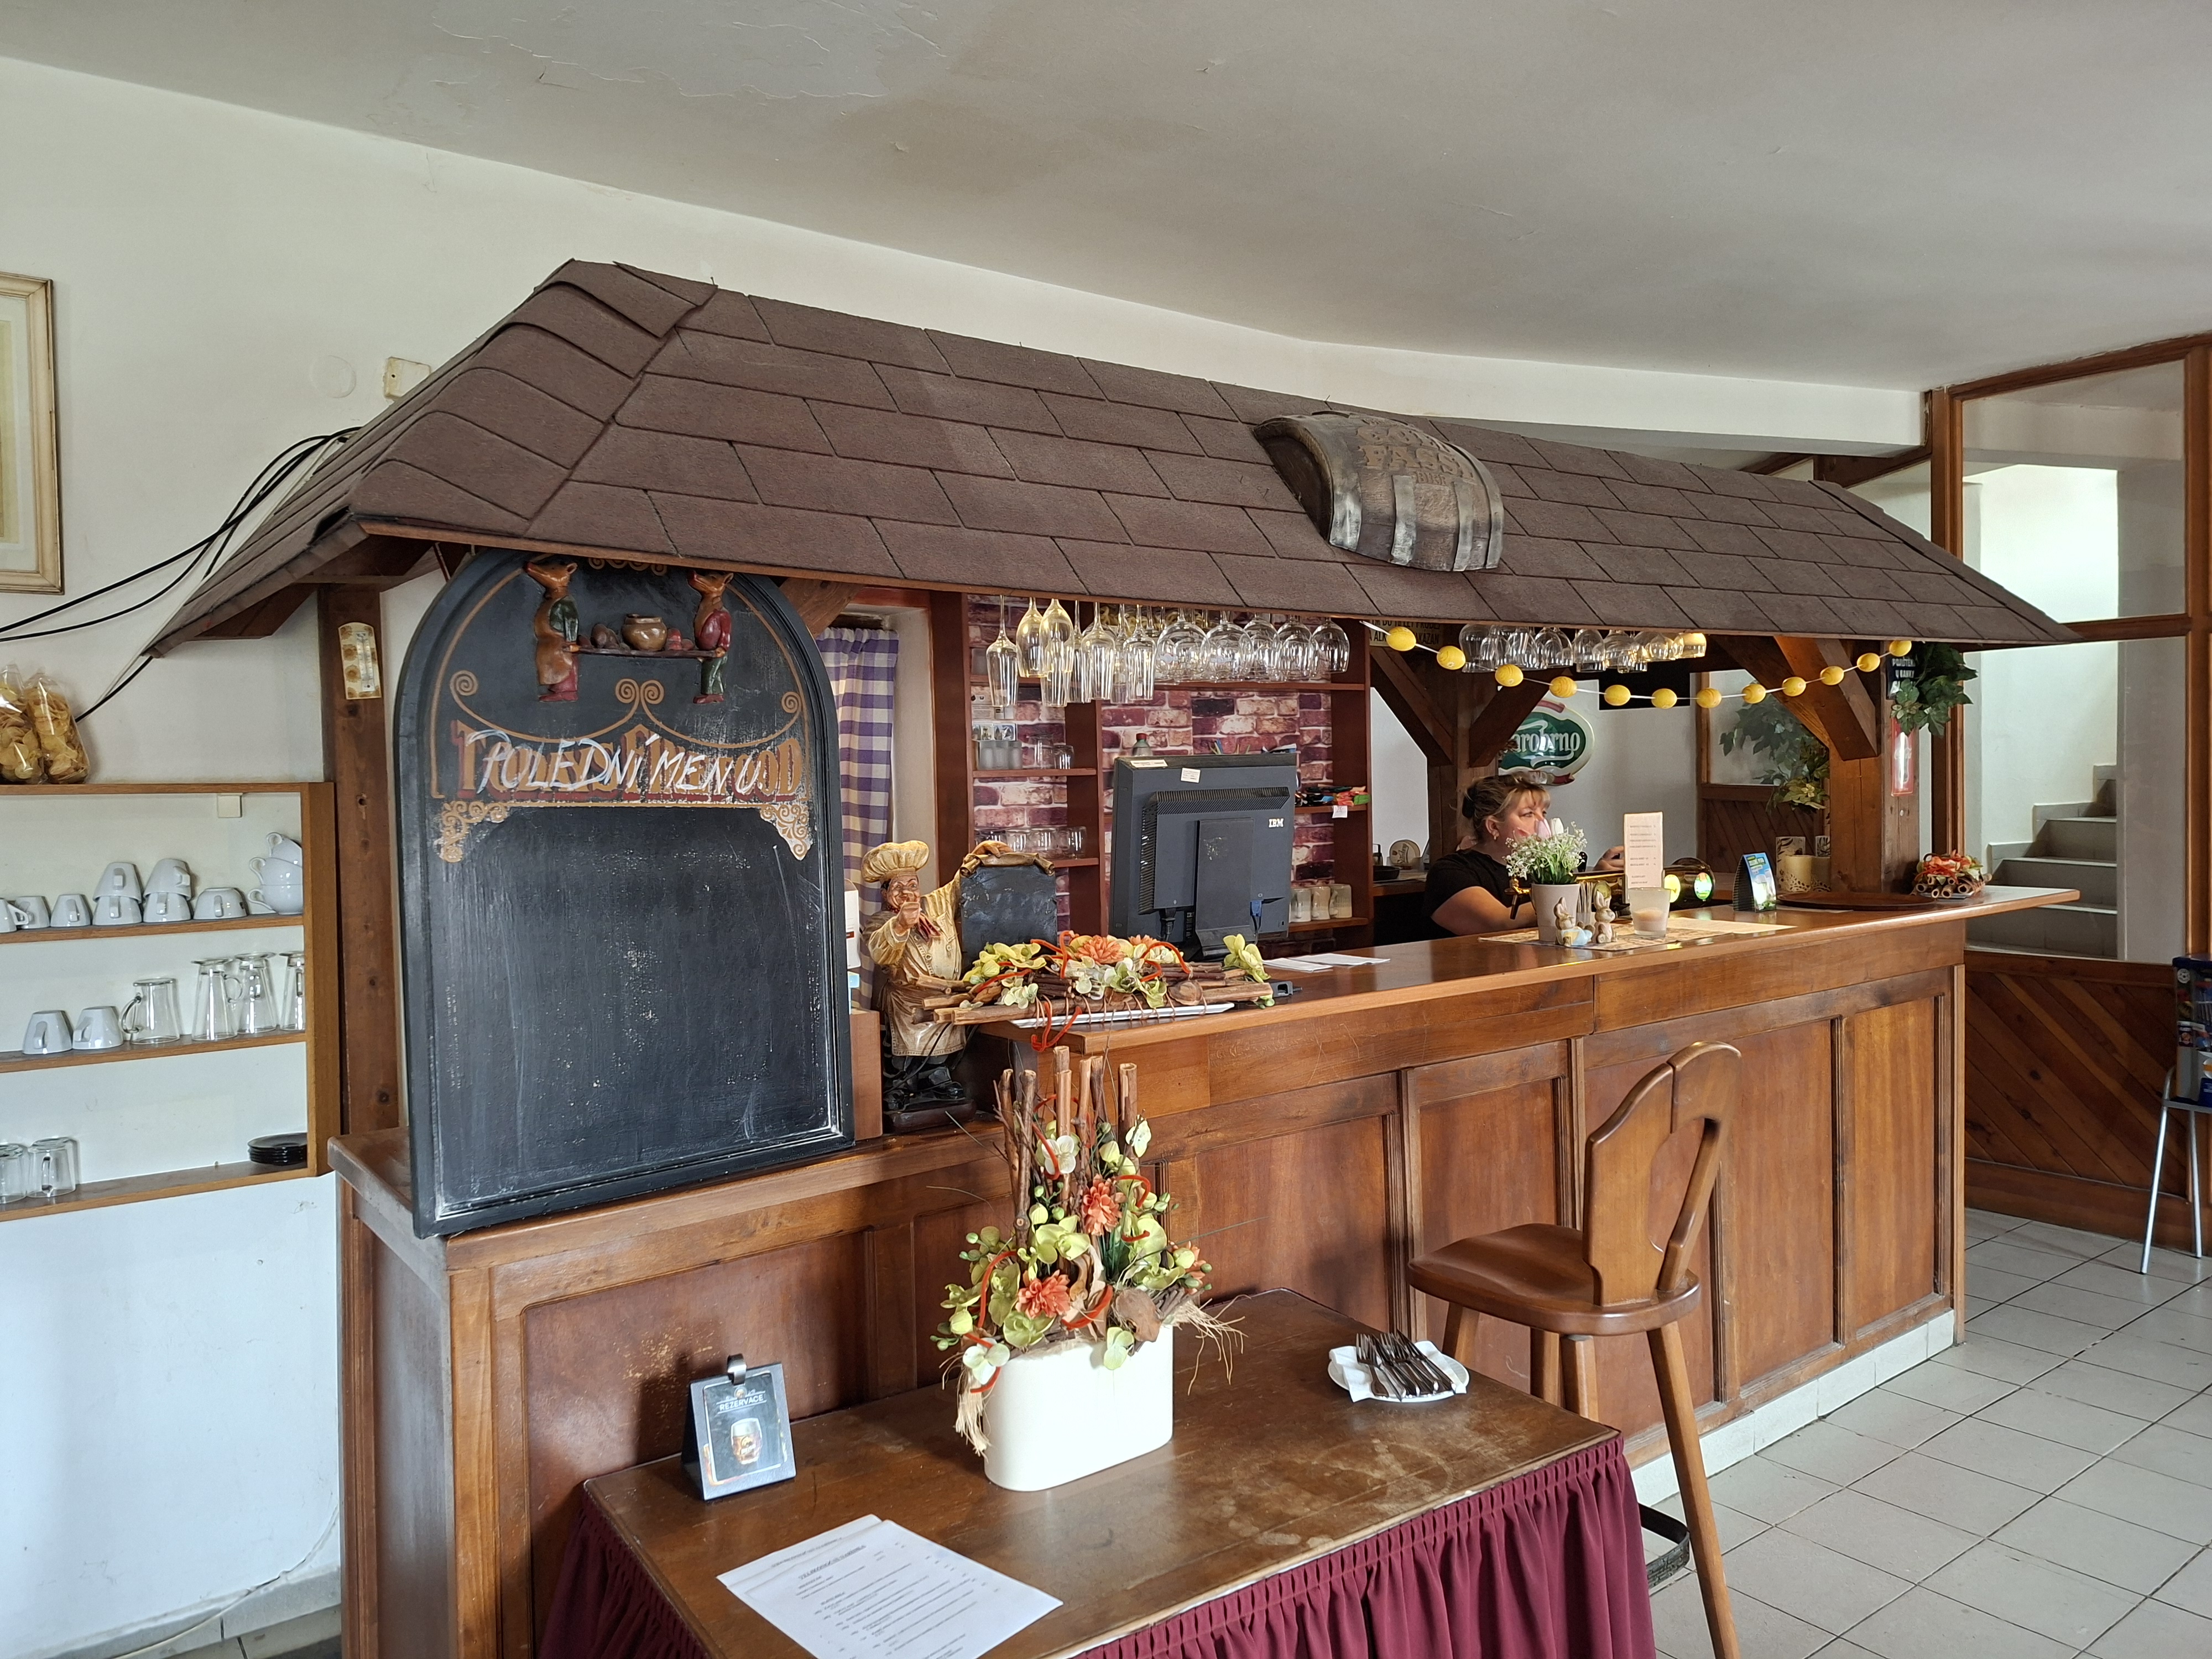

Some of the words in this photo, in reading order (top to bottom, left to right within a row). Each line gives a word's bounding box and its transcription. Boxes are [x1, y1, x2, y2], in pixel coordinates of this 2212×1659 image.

[1511, 721, 1581, 754] arobrno
[1268, 818, 1285, 828] IBM
[719, 1394, 764, 1411] REZERVACE
